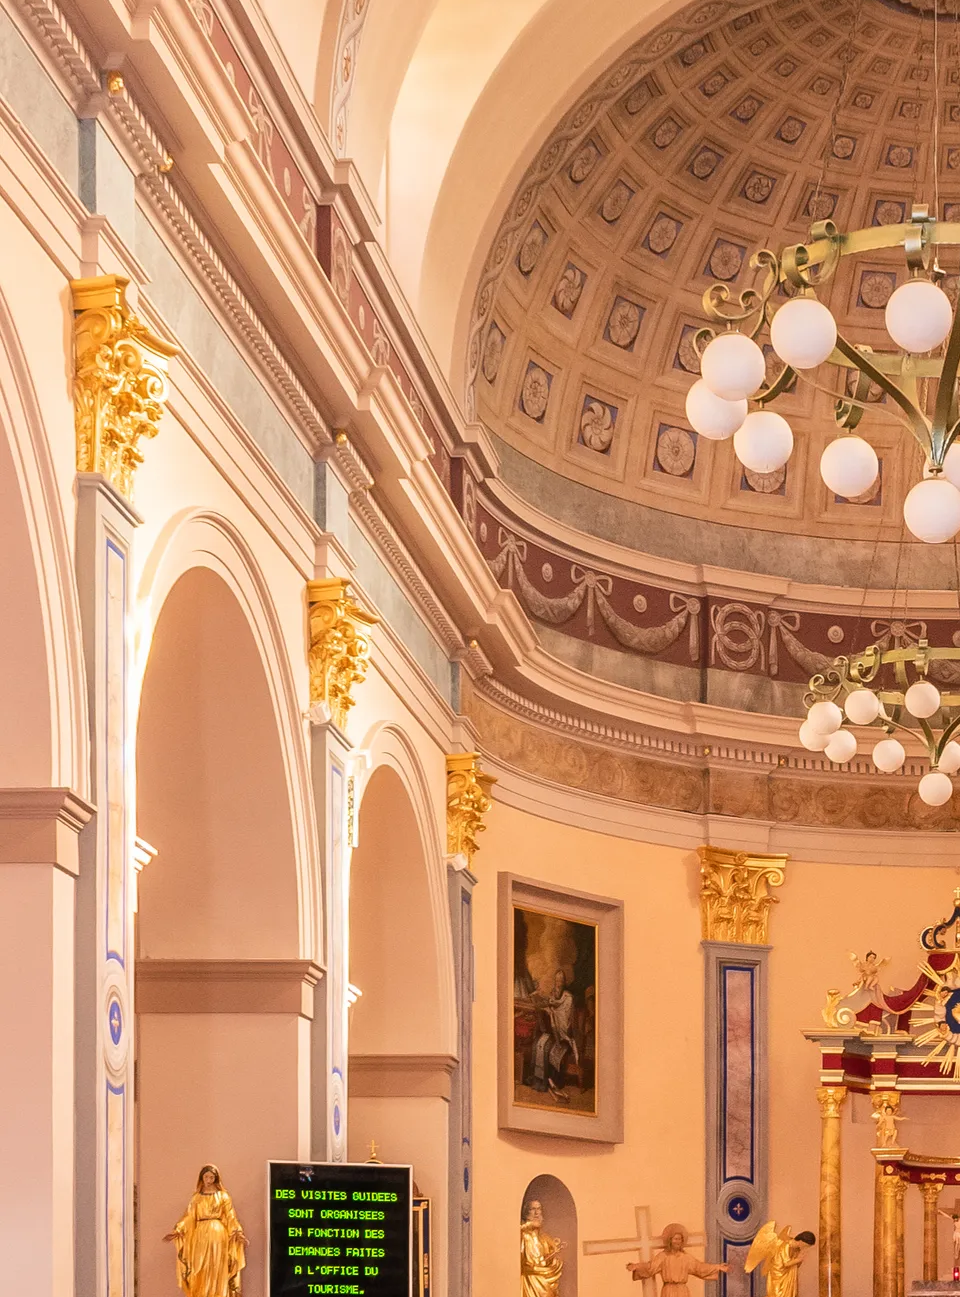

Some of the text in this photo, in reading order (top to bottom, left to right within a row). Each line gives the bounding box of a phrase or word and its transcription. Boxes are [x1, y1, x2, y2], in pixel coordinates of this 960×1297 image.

[275, 1189, 398, 1202] DES VISITES GUIDEES
[288, 1208, 385, 1220] SONT ORGANISEES
[288, 1227, 385, 1239] EN FONCTION DES
[288, 1246, 386, 1258] DEMANDES FAITES
[294, 1266, 379, 1276] A L'OFFICE DU
[307, 1284, 365, 1295] TOURISME.
